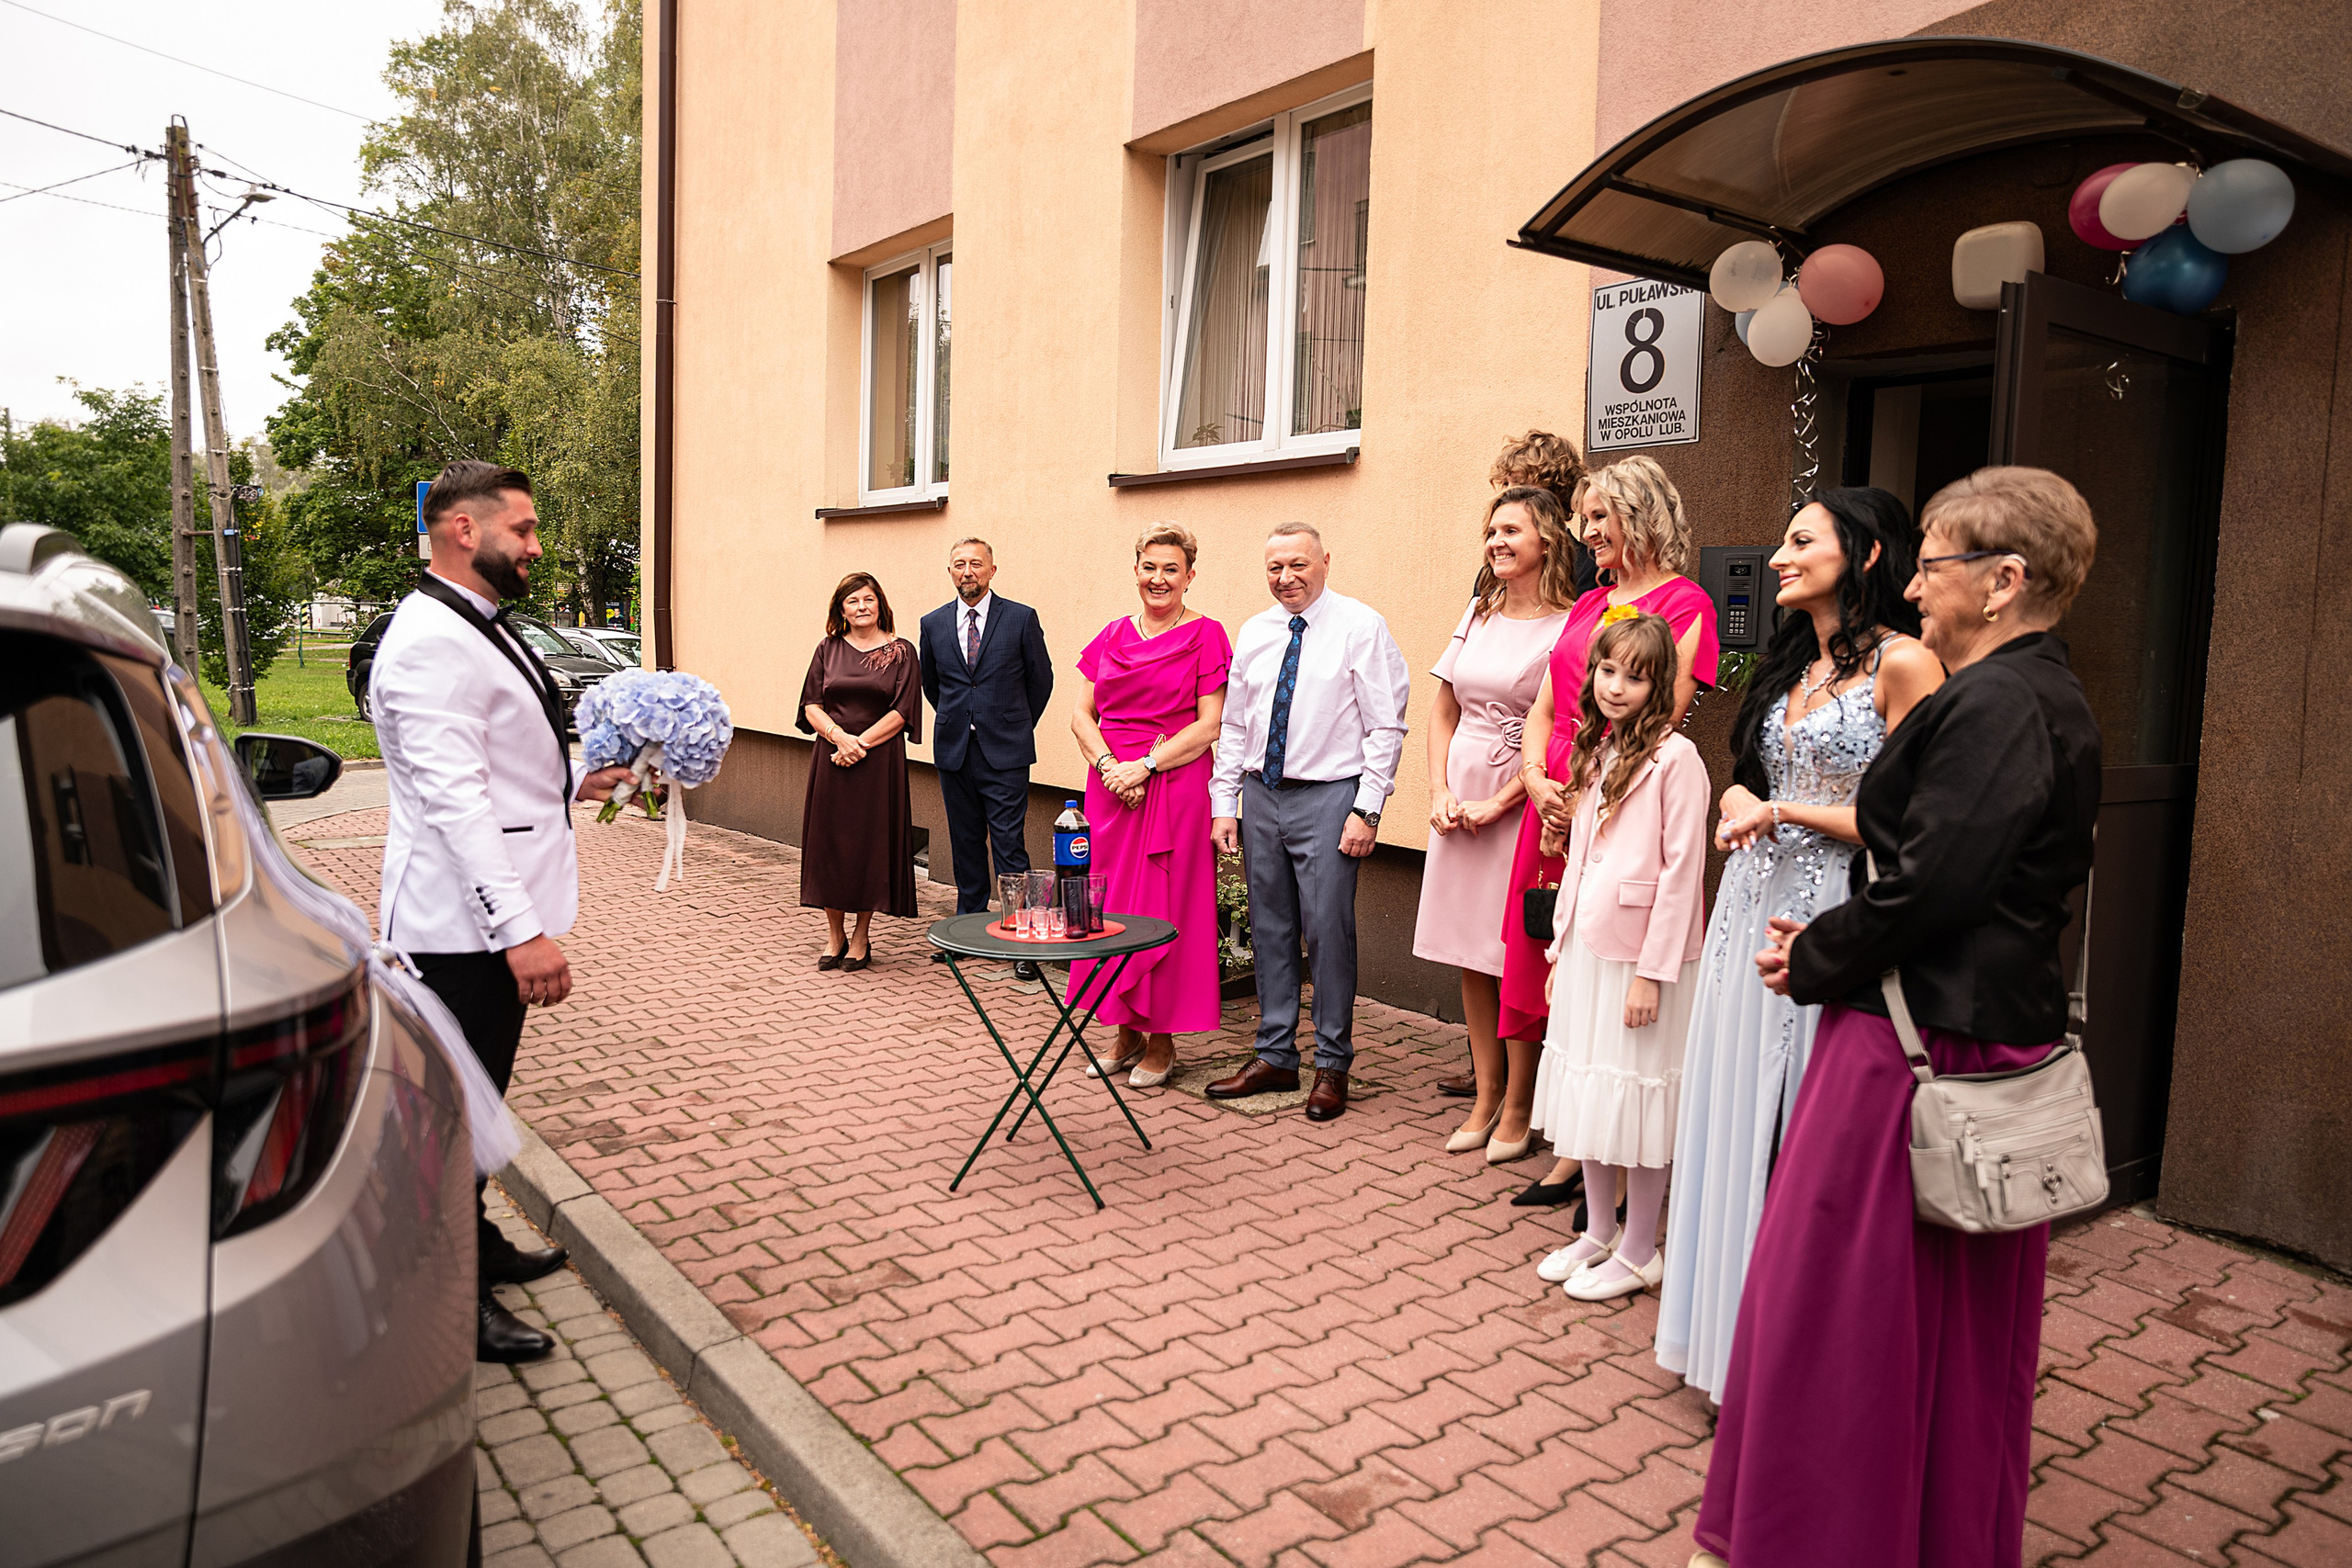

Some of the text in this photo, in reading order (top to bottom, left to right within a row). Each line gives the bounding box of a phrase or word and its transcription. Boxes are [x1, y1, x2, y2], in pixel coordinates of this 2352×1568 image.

[1620, 308, 1665, 393] 8
[1605, 397, 1678, 416] WSPÓLNOTA
[1599, 410, 1686, 430] MIESZKANIOWA
[1600, 423, 1685, 441] W OPOLU LUB.
